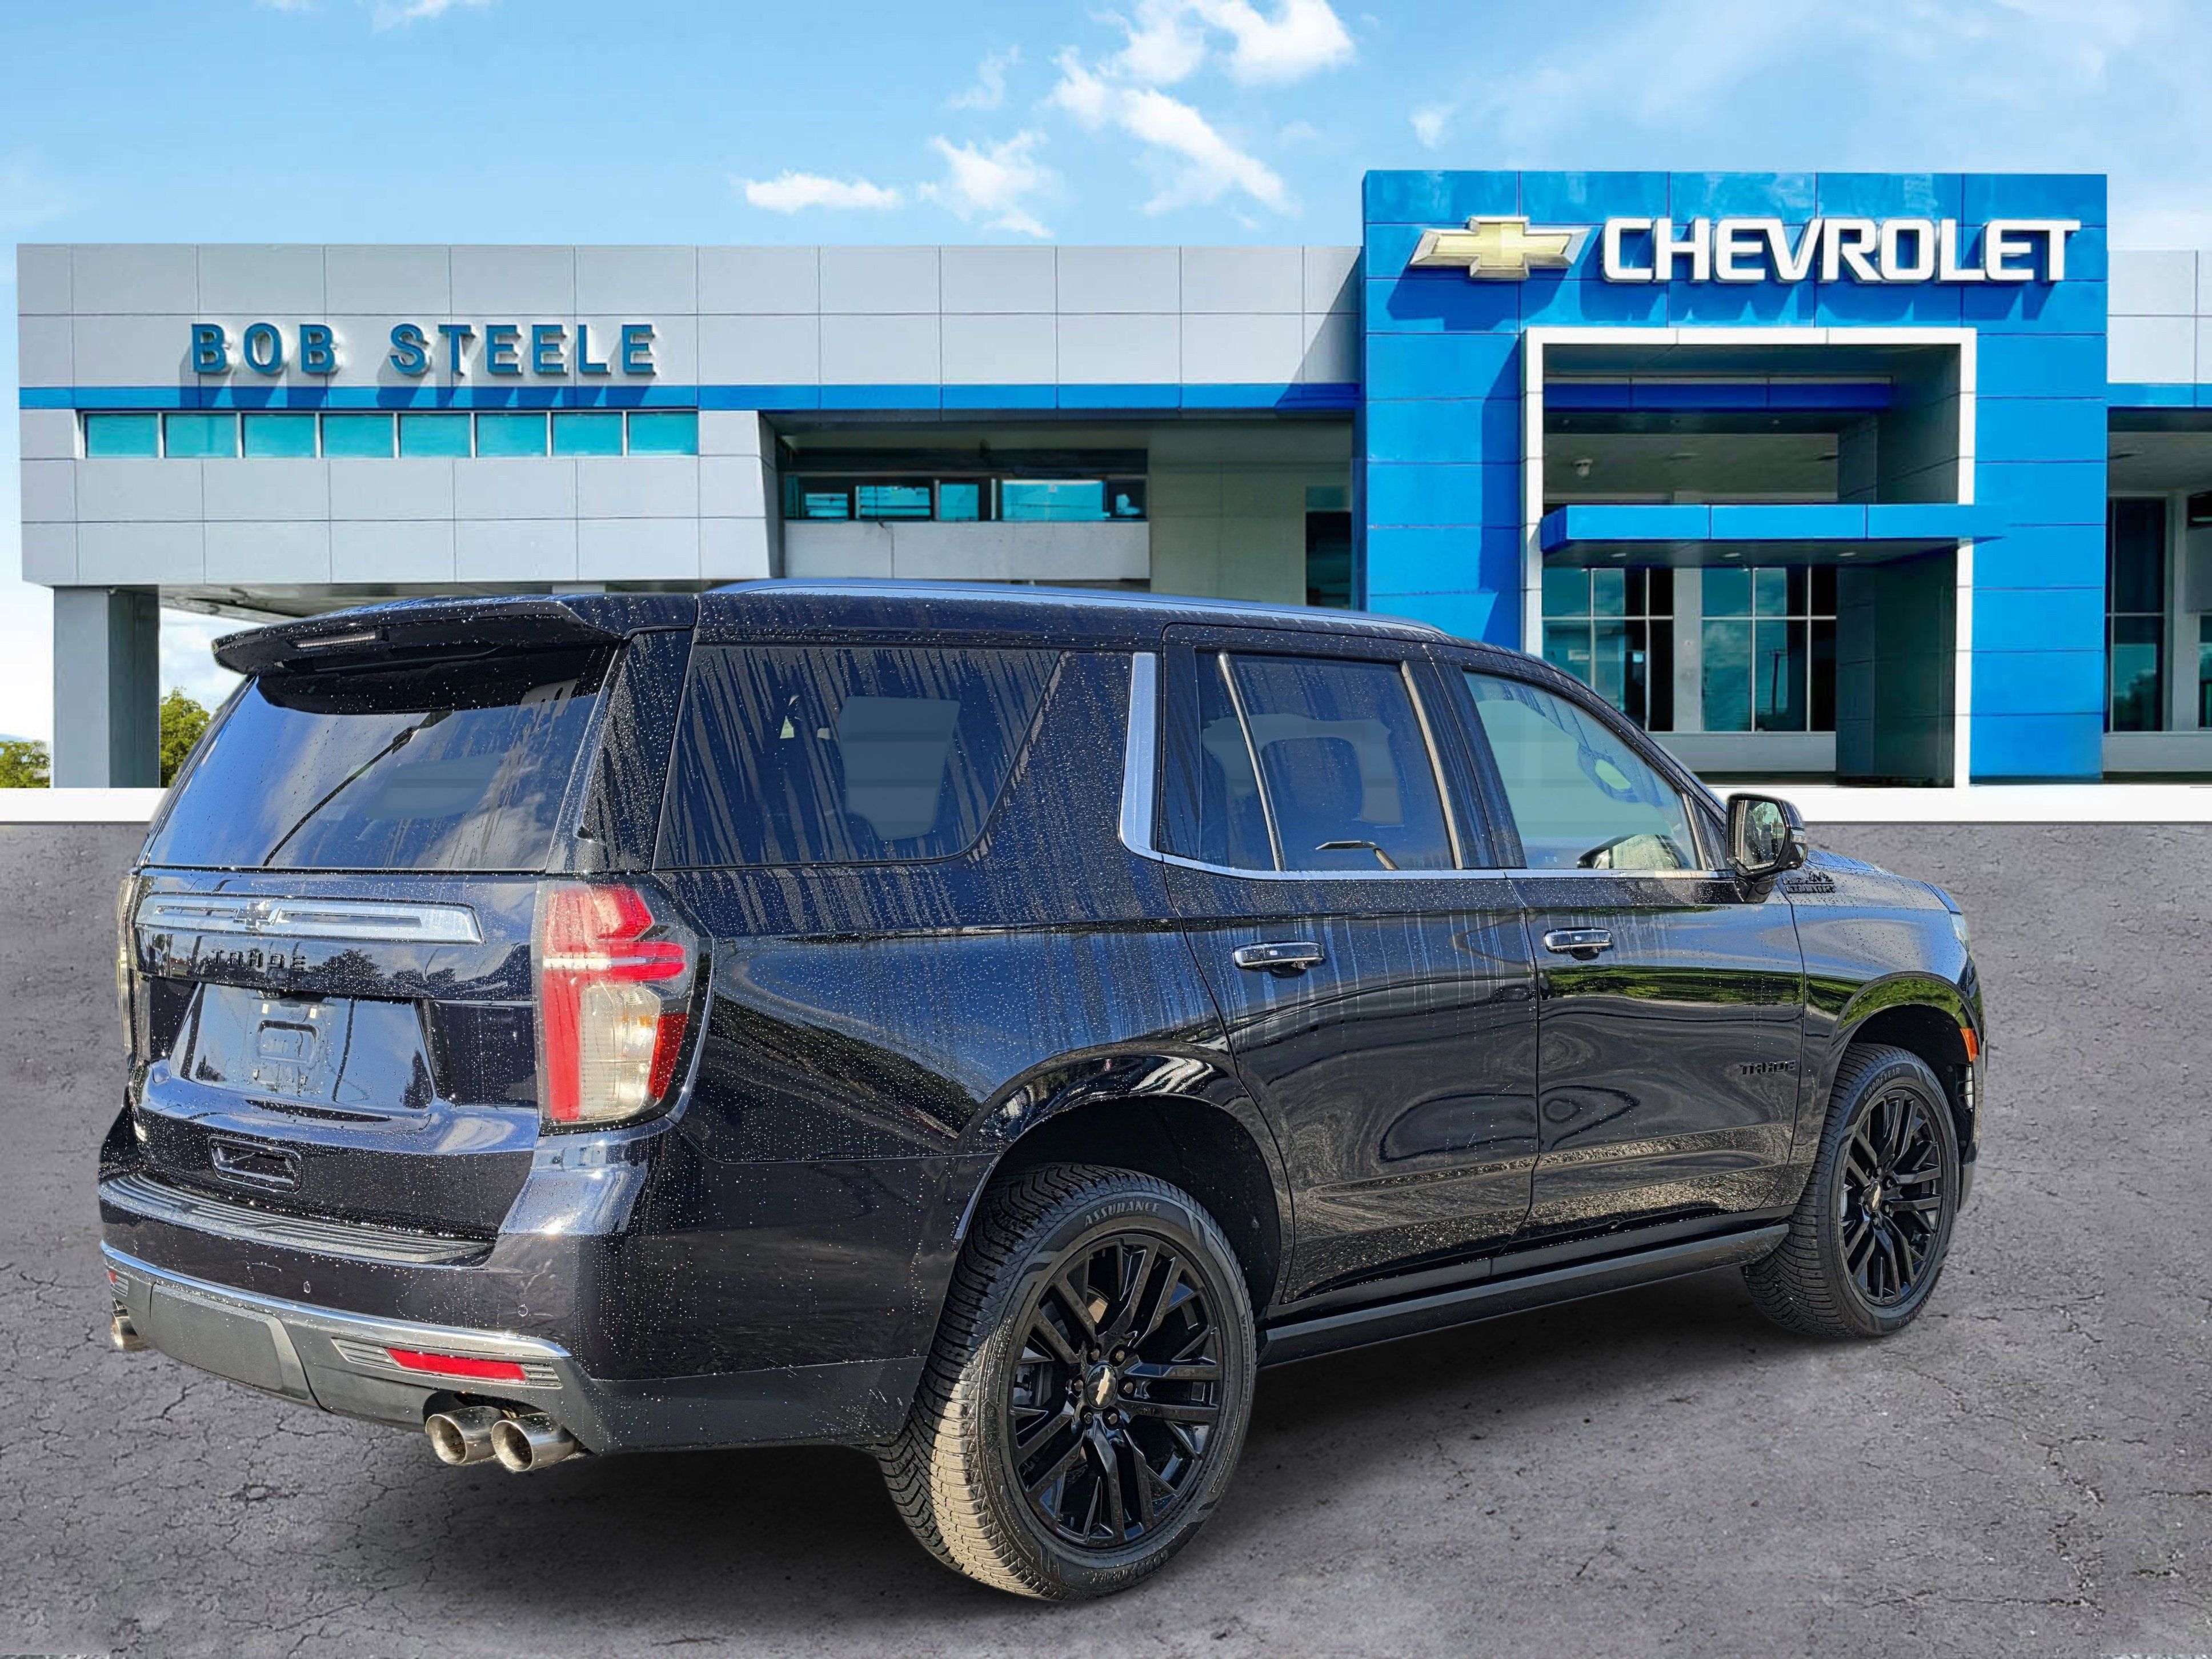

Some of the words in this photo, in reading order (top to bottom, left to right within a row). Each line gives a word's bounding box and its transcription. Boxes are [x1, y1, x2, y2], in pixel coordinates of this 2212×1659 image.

[1601, 217, 2081, 283] CHEVROLET
[191, 322, 338, 376] BOB
[389, 322, 657, 376] STEELE
[211, 948, 306, 972] TAHOE
[1085, 1200, 1161, 1228] ASSURANCE
